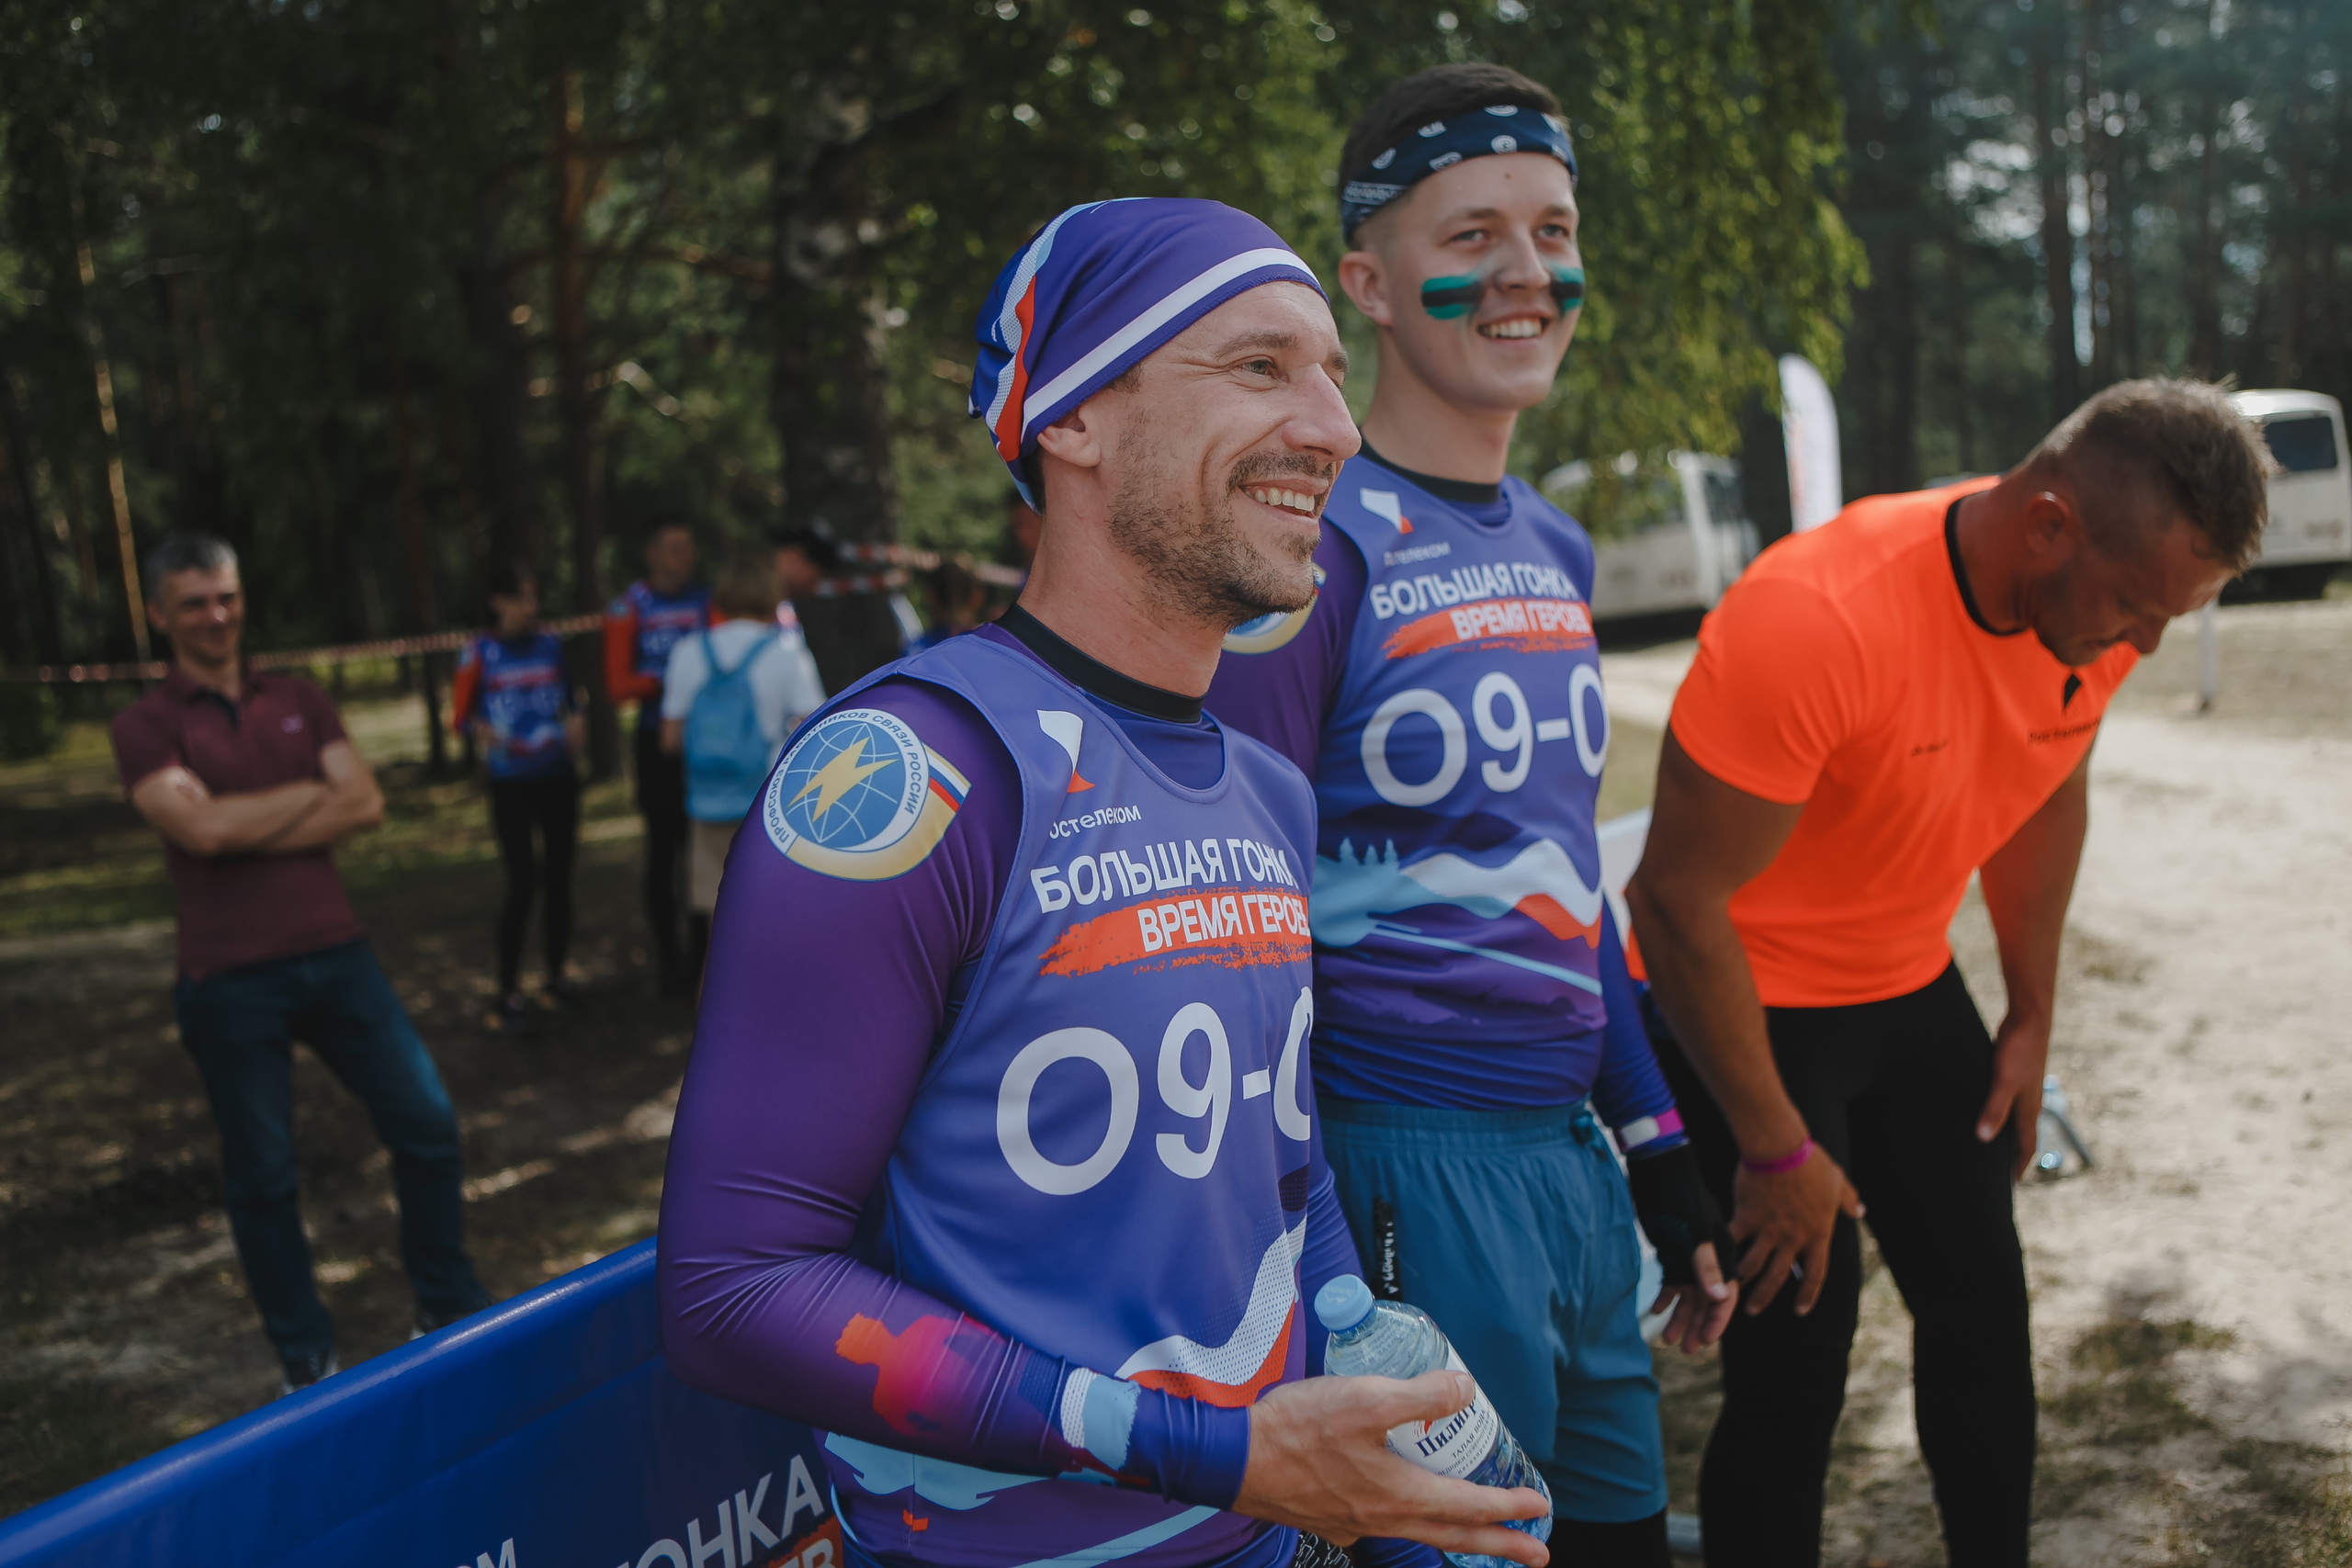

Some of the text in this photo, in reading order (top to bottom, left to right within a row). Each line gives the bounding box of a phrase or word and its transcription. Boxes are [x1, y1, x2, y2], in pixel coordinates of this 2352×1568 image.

[1370, 562, 1515, 620] БОЛЬШАЯ
[1449, 602, 1529, 640] ВРЕМЯ
[767, 712, 922, 844] ПРОФСОЮЗ РАБОТНИКОВ СВЯЗИ РОССИИ
[1049, 805, 1142, 840] остелеком
[1030, 838, 1227, 915] БОЛЬШАЯ
[1136, 895, 1244, 953] ВРЕМЯ
[1414, 1395, 1476, 1459] Пилигр
[1452, 1433, 1476, 1459] ТАЛАЯ
